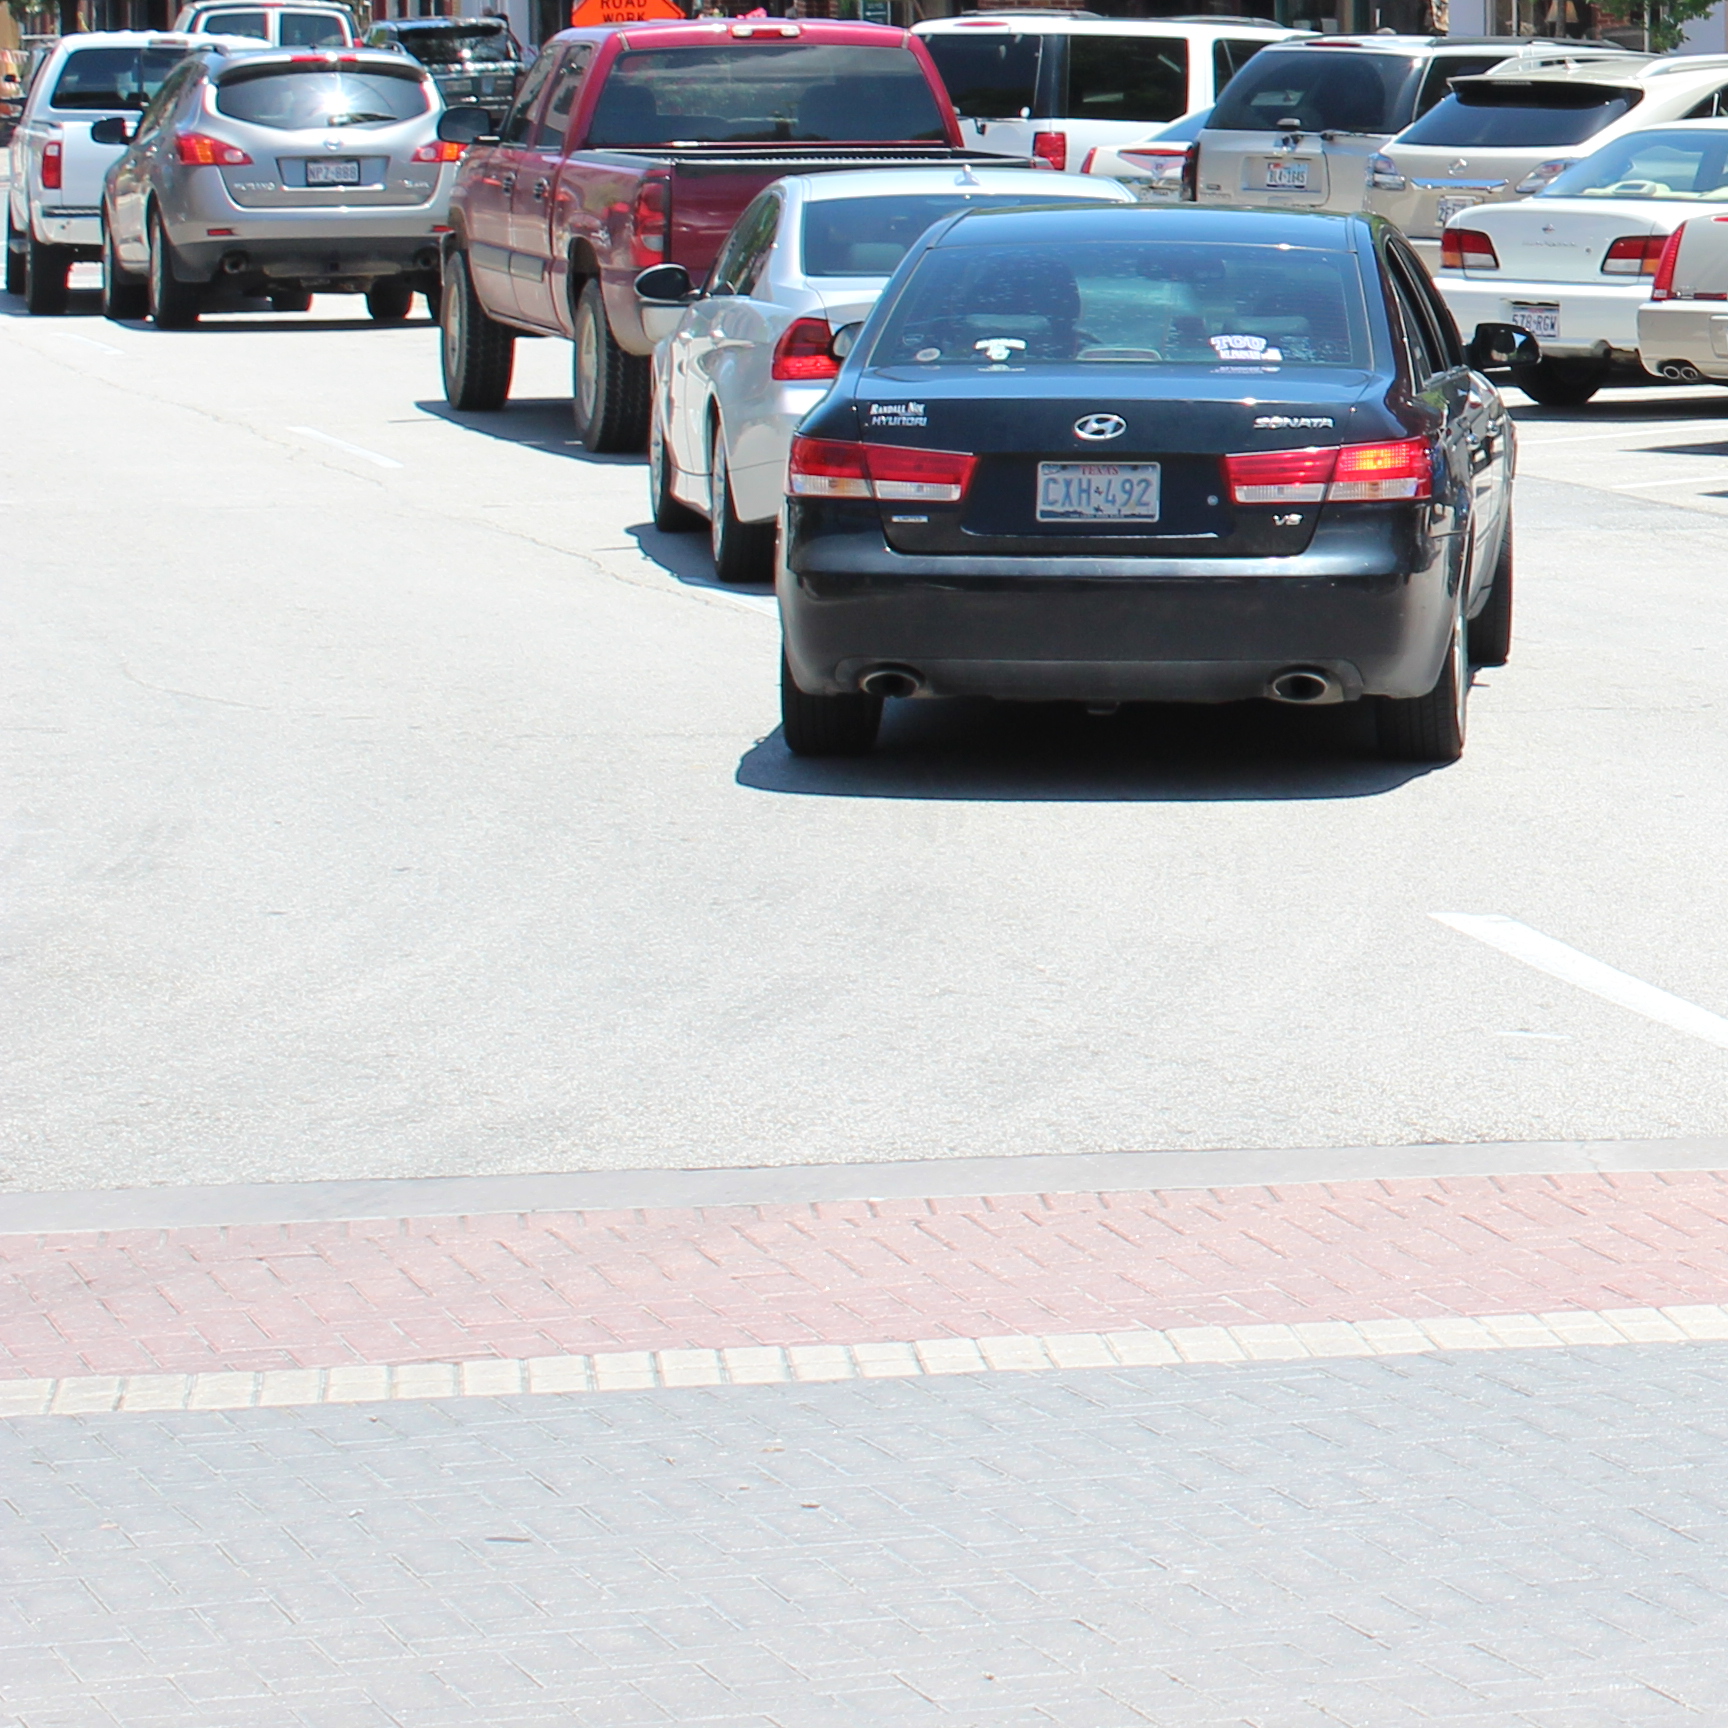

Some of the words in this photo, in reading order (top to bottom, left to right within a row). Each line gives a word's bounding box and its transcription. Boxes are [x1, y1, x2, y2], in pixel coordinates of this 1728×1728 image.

[602, 12, 646, 22] WORK
[871, 416, 927, 426] HYUNDAI
[1253, 416, 1335, 429] SONATA
[1080, 465, 1120, 476] TEXAS
